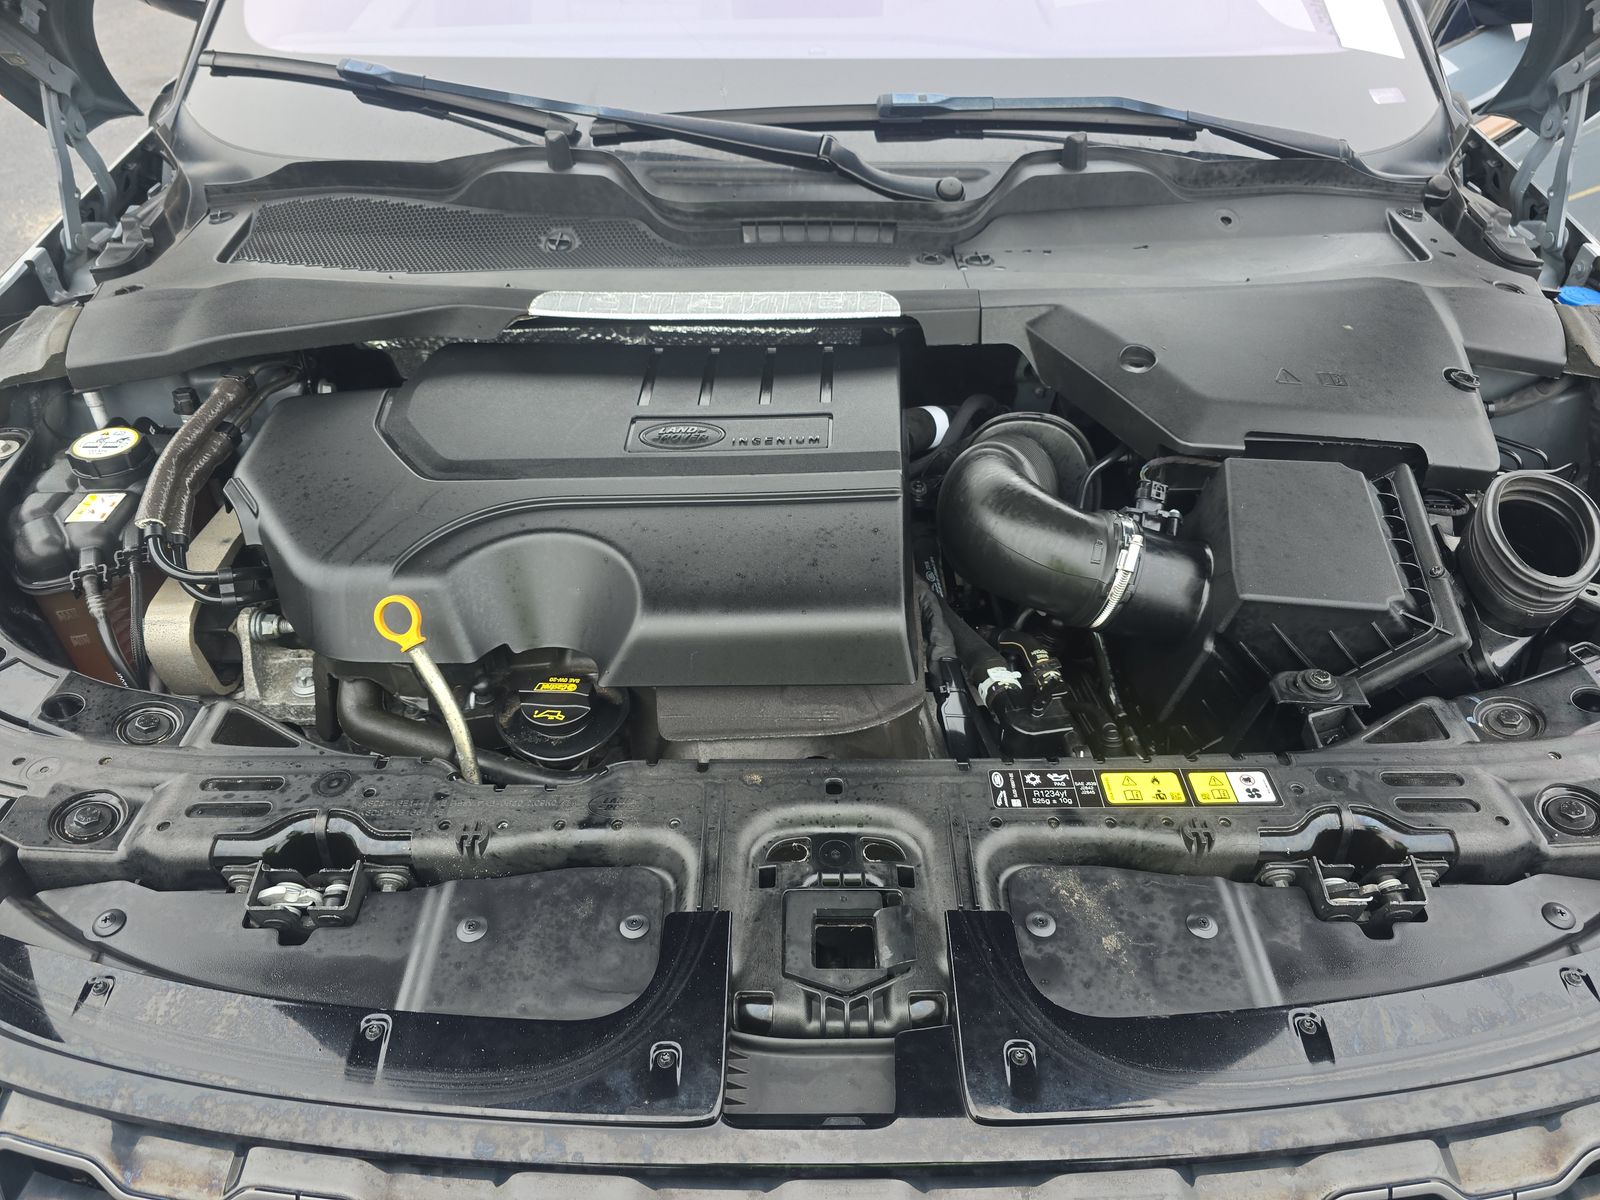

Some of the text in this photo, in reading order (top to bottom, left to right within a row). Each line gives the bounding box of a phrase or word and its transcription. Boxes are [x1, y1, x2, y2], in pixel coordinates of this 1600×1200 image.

[658, 426, 698, 434] LAND
[732, 435, 820, 446] INGENIUM
[1033, 790, 1068, 798] R1234yf
[1059, 797, 1072, 805] 10g
